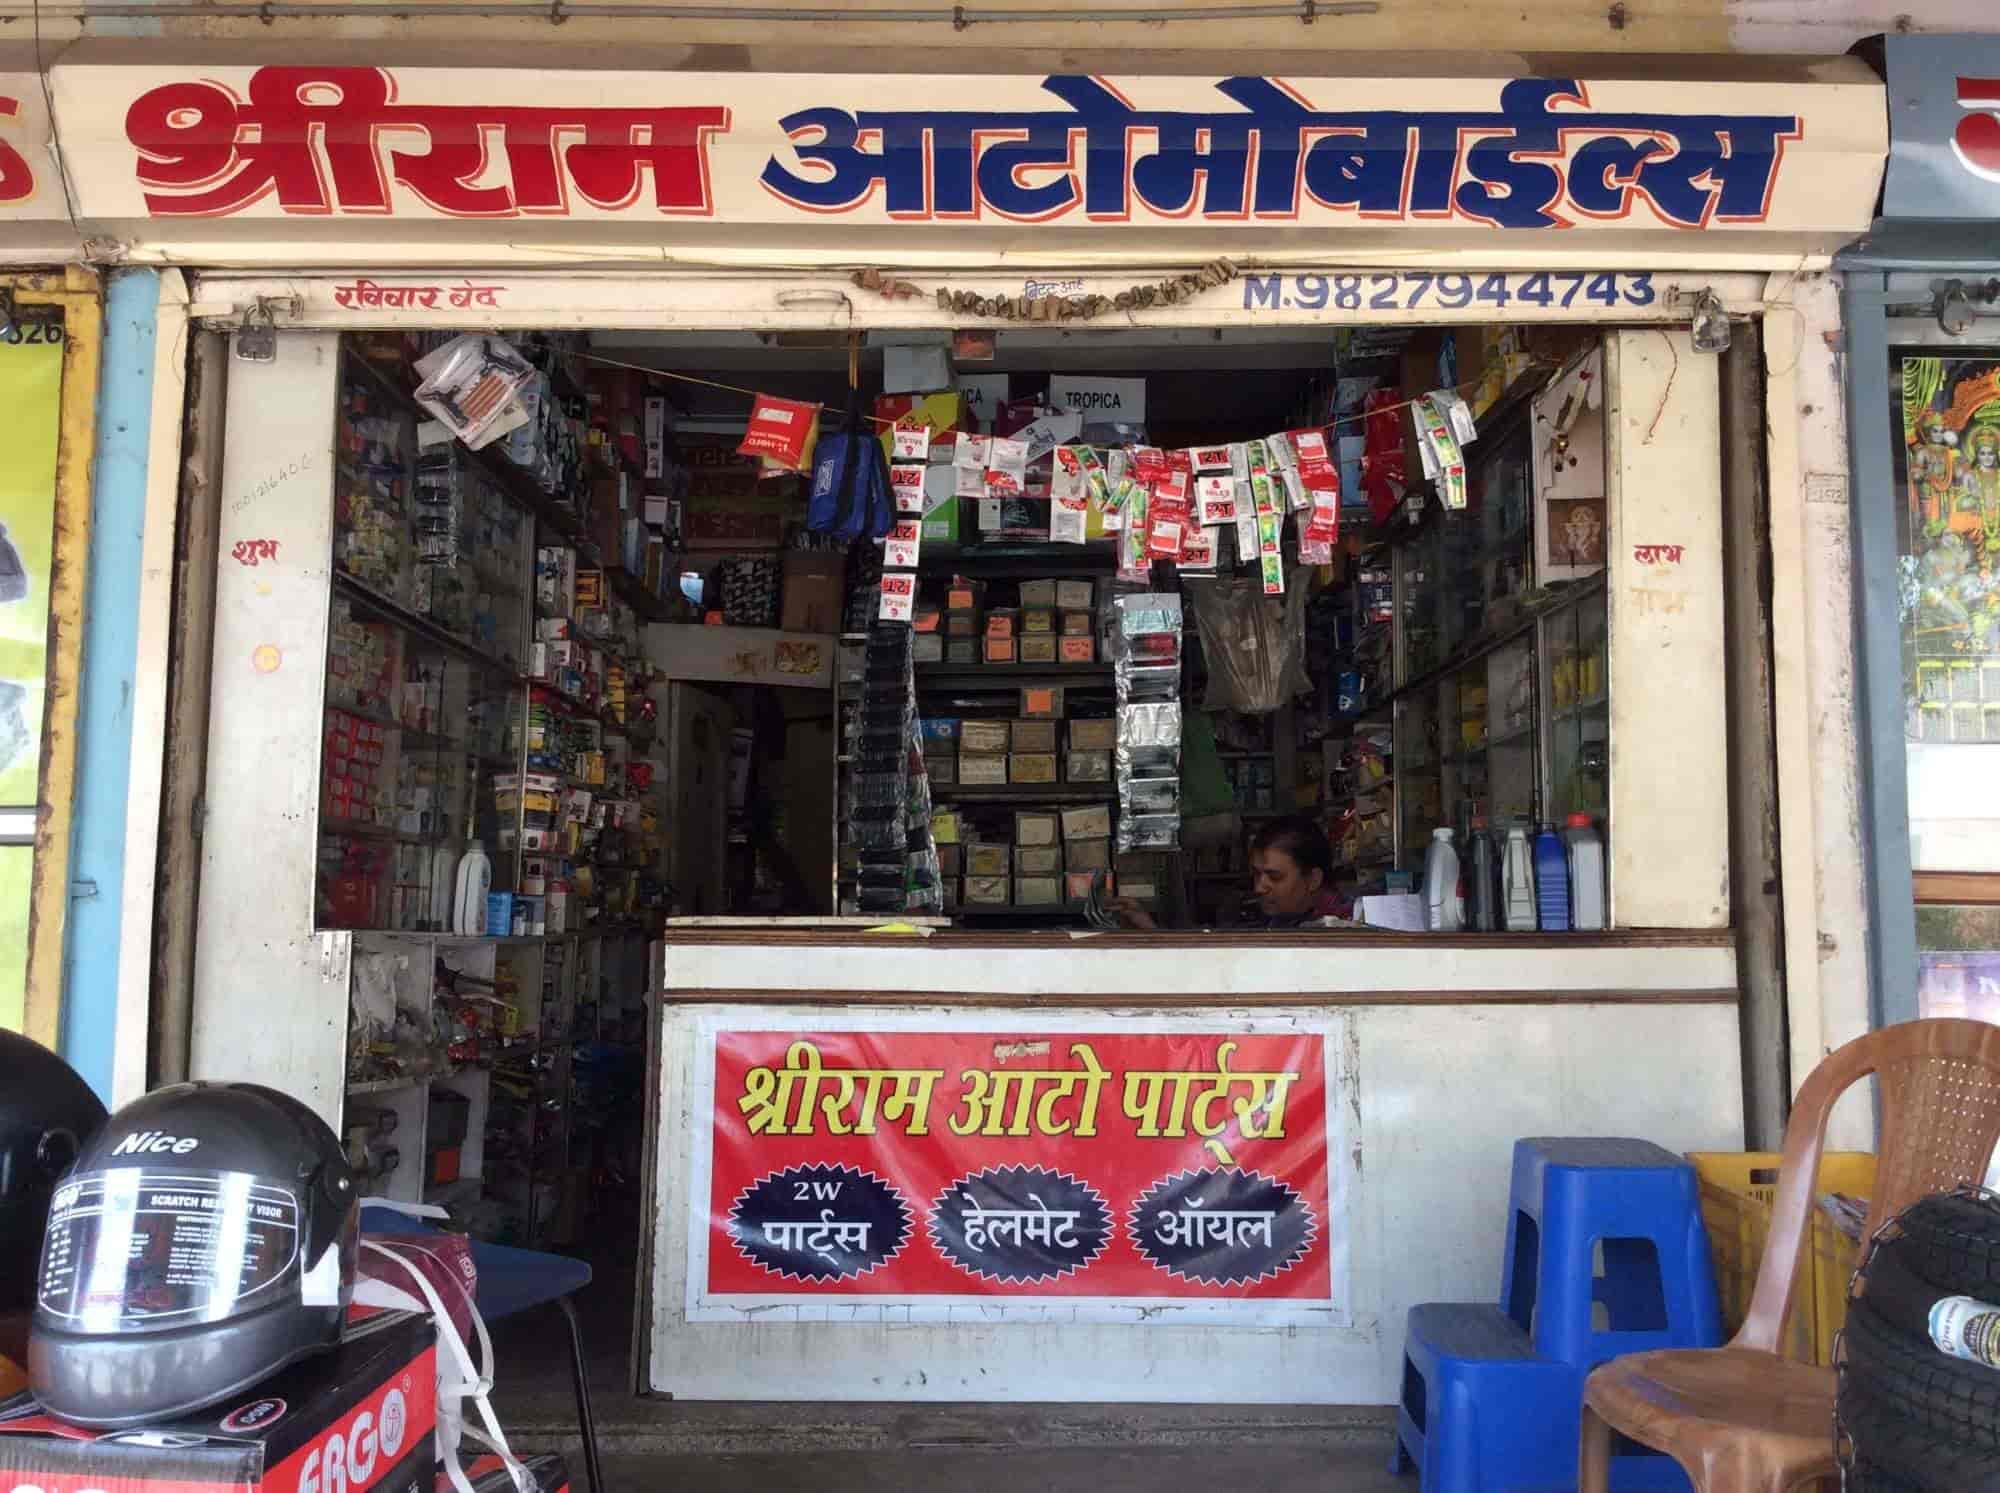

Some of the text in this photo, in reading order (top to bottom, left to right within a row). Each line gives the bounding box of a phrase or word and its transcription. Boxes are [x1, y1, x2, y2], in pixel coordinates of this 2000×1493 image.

[126, 65, 731, 217] श्रीराम
[334, 280, 445, 310] रविवार
[1243, 272, 1655, 310] M.9827944743
[1065, 392, 1121, 408] TROPICA
[232, 539, 280, 566] शुभ
[1633, 544, 1685, 565] लाभ
[738, 1041, 1300, 1164] श्रीराम आटो पार्ट्स
[112, 1131, 199, 1156] Nice
[151, 1195, 199, 1208] SCRATCH
[256, 1205, 283, 1217] VISOR
[793, 1181, 843, 1201] 2W
[762, 1208, 872, 1267] पार्ट्स
[962, 1193, 1080, 1255] हेलमेट
[1155, 1198, 1275, 1248] ऑयल
